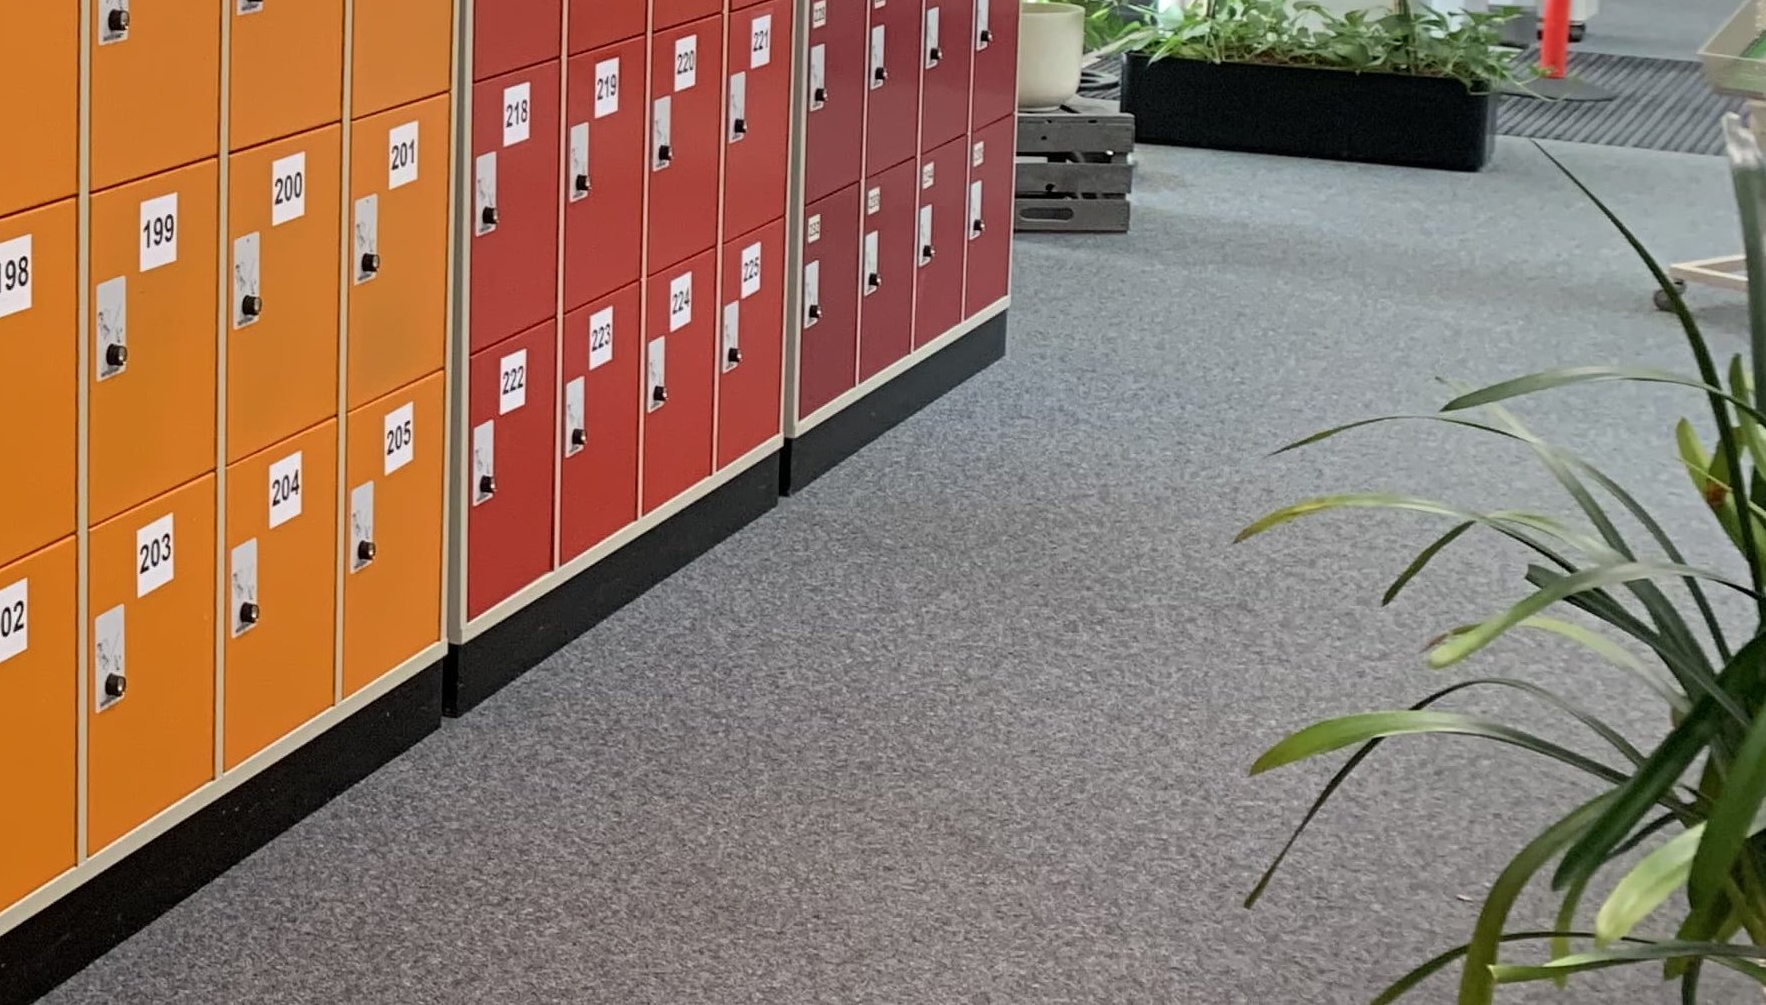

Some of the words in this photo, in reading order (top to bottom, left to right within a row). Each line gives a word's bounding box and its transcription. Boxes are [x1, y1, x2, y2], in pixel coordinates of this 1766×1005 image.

[753, 28, 768, 52] 221
[676, 50, 693, 75] 220
[597, 74, 616, 101] 219
[505, 99, 528, 128] 218
[391, 140, 415, 171] 201
[274, 171, 303, 205] 200
[143, 213, 175, 248] 199
[743, 256, 759, 282] 225
[672, 286, 690, 314] 224
[591, 322, 610, 351] 223
[502, 365, 523, 395] 222
[386, 425, 411, 456] 205
[272, 469, 300, 507] 204
[139, 533, 171, 575] 203
